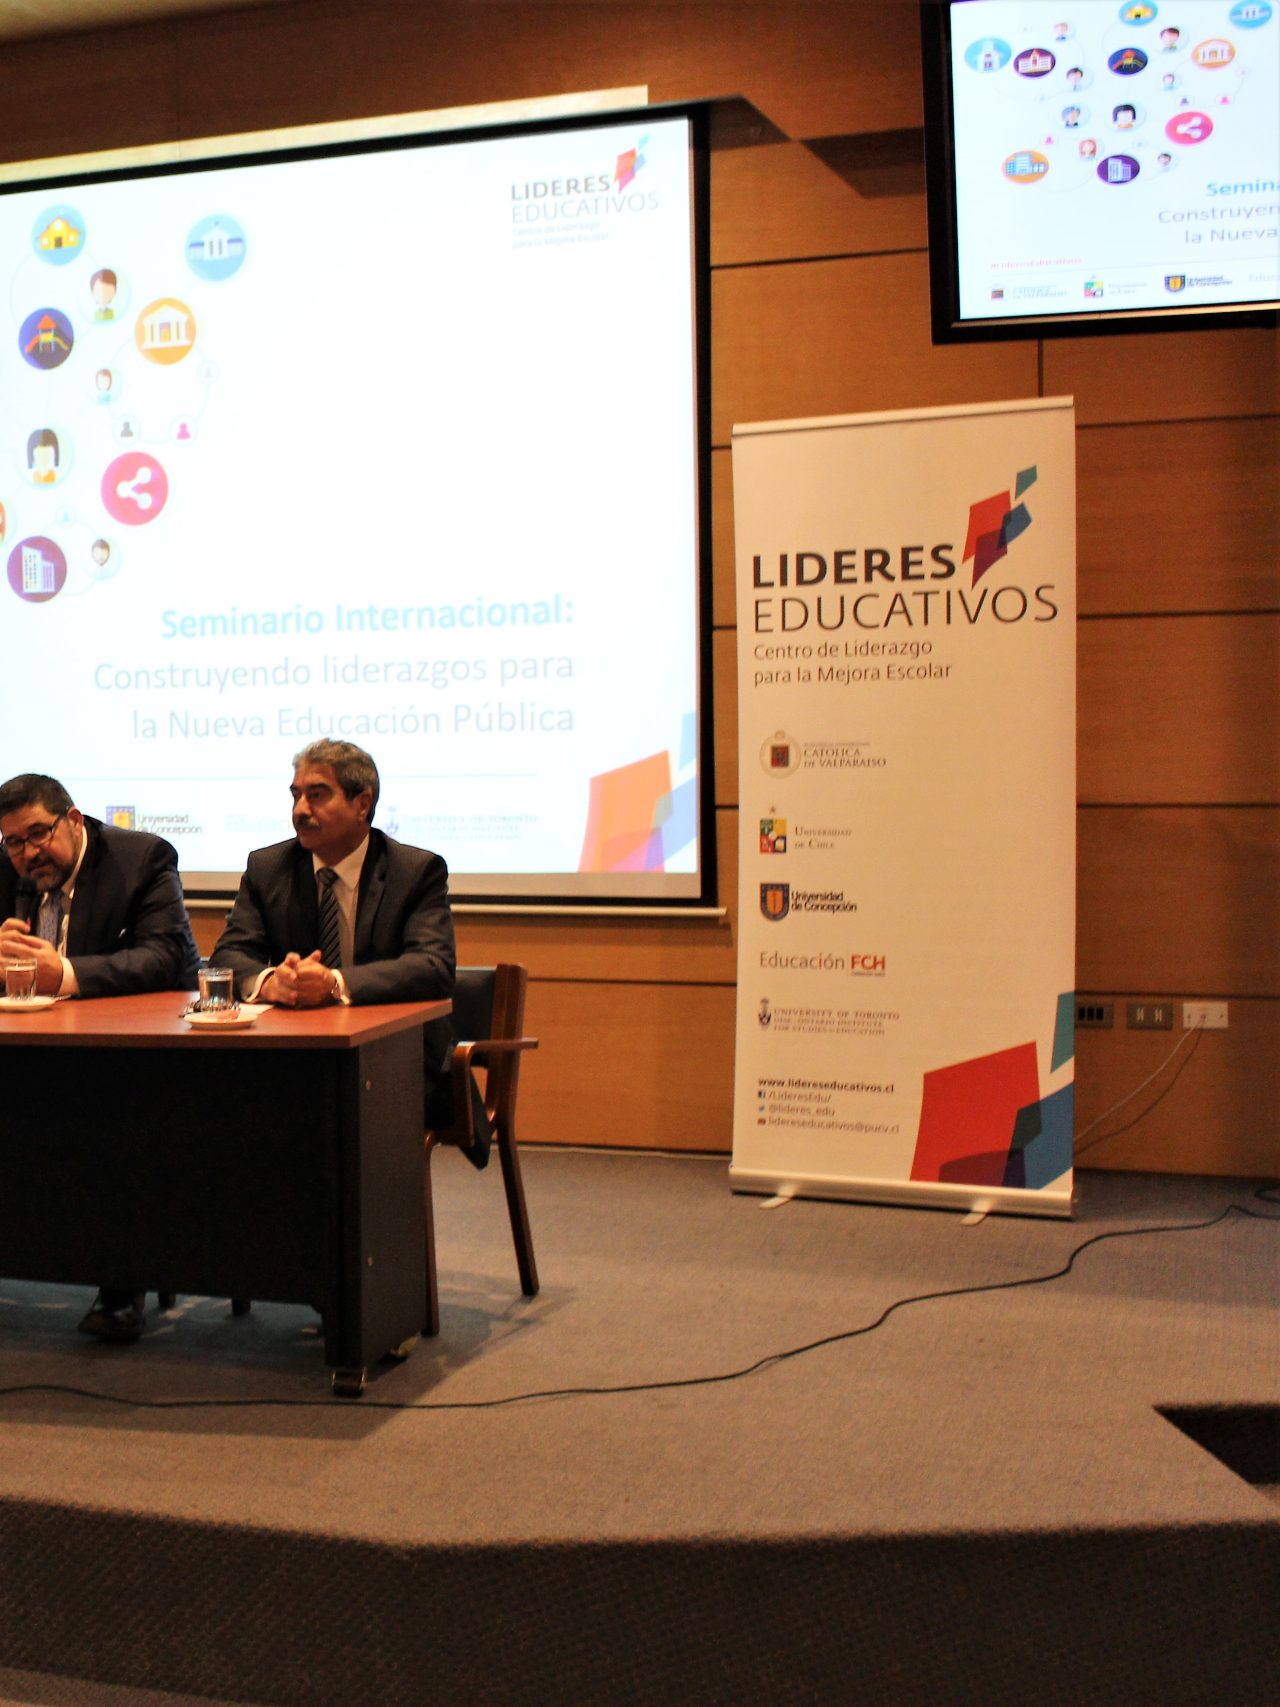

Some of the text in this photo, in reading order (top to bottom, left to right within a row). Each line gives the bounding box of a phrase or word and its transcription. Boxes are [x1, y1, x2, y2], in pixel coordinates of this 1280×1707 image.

[511, 175, 610, 201] LIDERES
[512, 191, 659, 223] EDUCATIVOS
[1185, 227, 1278, 244] la Nueva
[753, 544, 957, 589] LIDERES
[161, 593, 574, 639] Seminario Internacional:
[754, 585, 1059, 633] EDUCATIVOS
[754, 640, 933, 660] Centro de Liderazgo
[94, 654, 574, 695] Construyendo liderazgos para
[754, 663, 953, 687] para la Mejora Escolar
[133, 702, 574, 739] la Nueva Educación Pública
[138, 814, 189, 825] Universidad
[791, 890, 844, 901] Universidad
[804, 901, 858, 914] Concepción
[760, 951, 886, 970] Educación FCH
[774, 1008, 833, 1017] UNIVERSITY
[855, 1010, 900, 1020] TORONTO
[758, 1079, 894, 1094] www.lidereseducativos.cl
